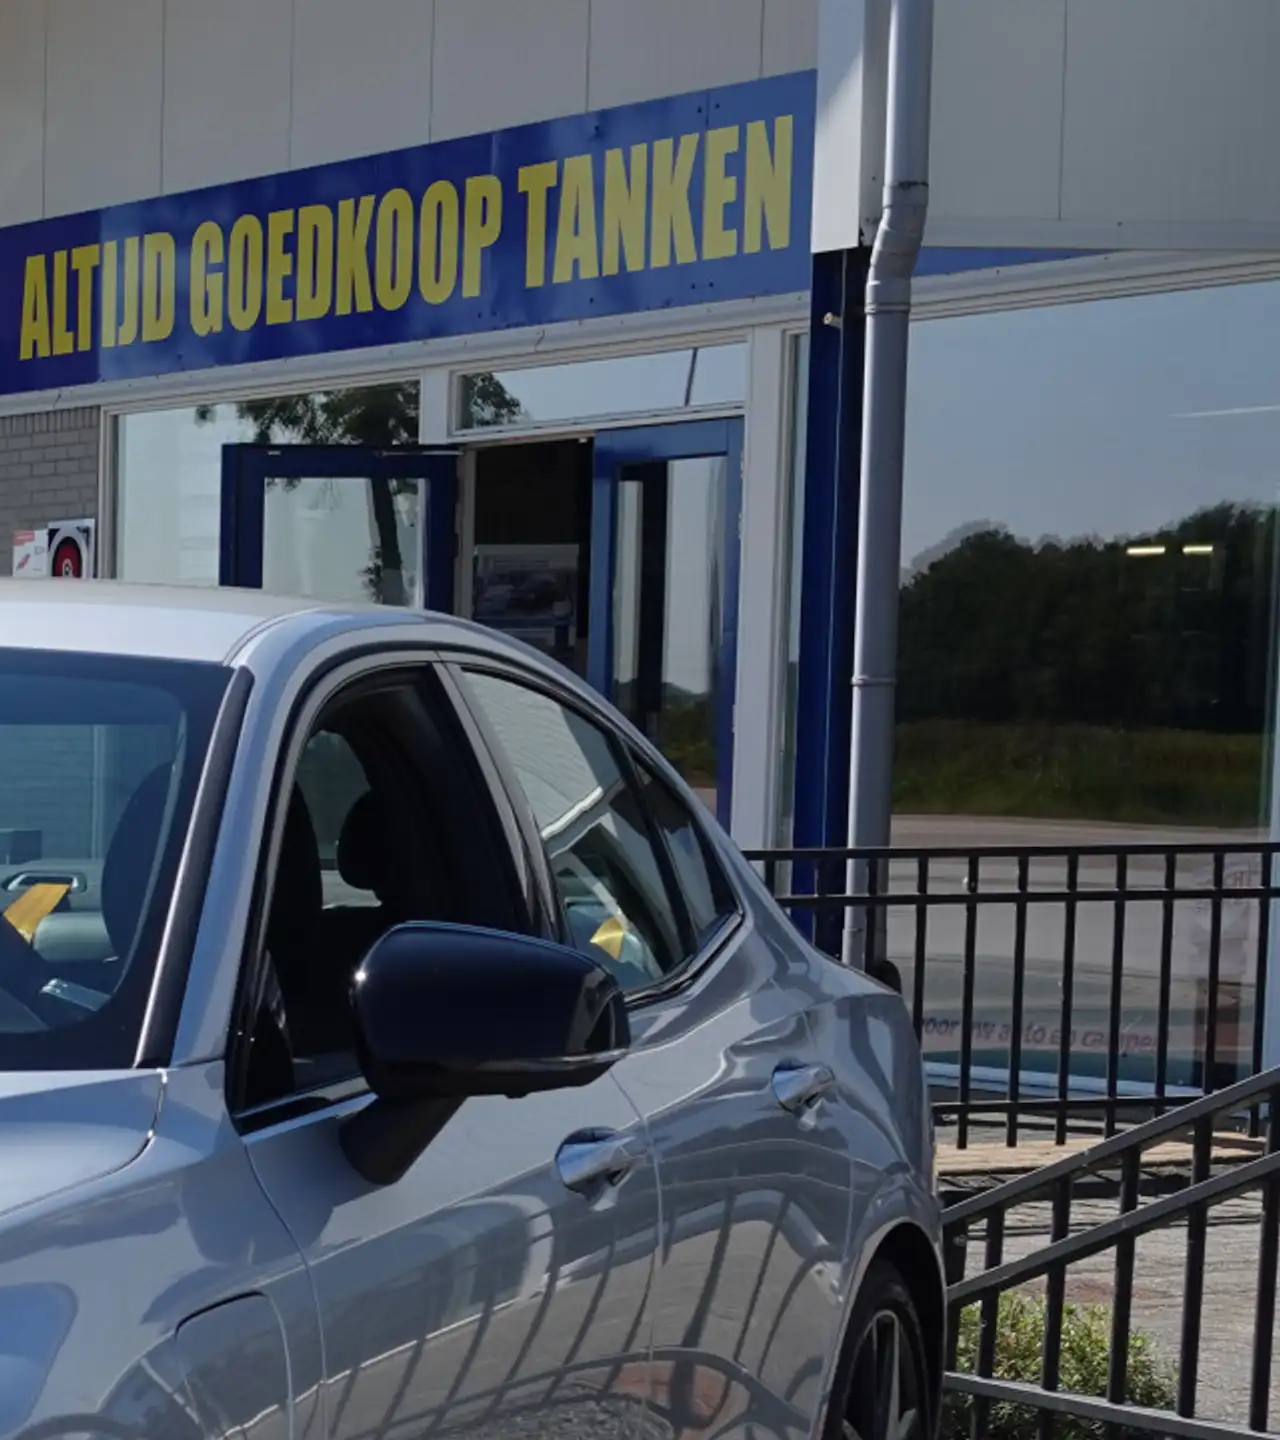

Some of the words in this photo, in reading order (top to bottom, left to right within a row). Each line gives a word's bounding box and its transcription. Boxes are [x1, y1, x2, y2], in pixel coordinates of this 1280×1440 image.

[19, 231, 176, 361] ALTIJD
[190, 173, 503, 338] GOEDKOOP
[518, 114, 794, 289] TANKEN
[922, 1016, 960, 1037] oor
[998, 1019, 1046, 1044] ato
